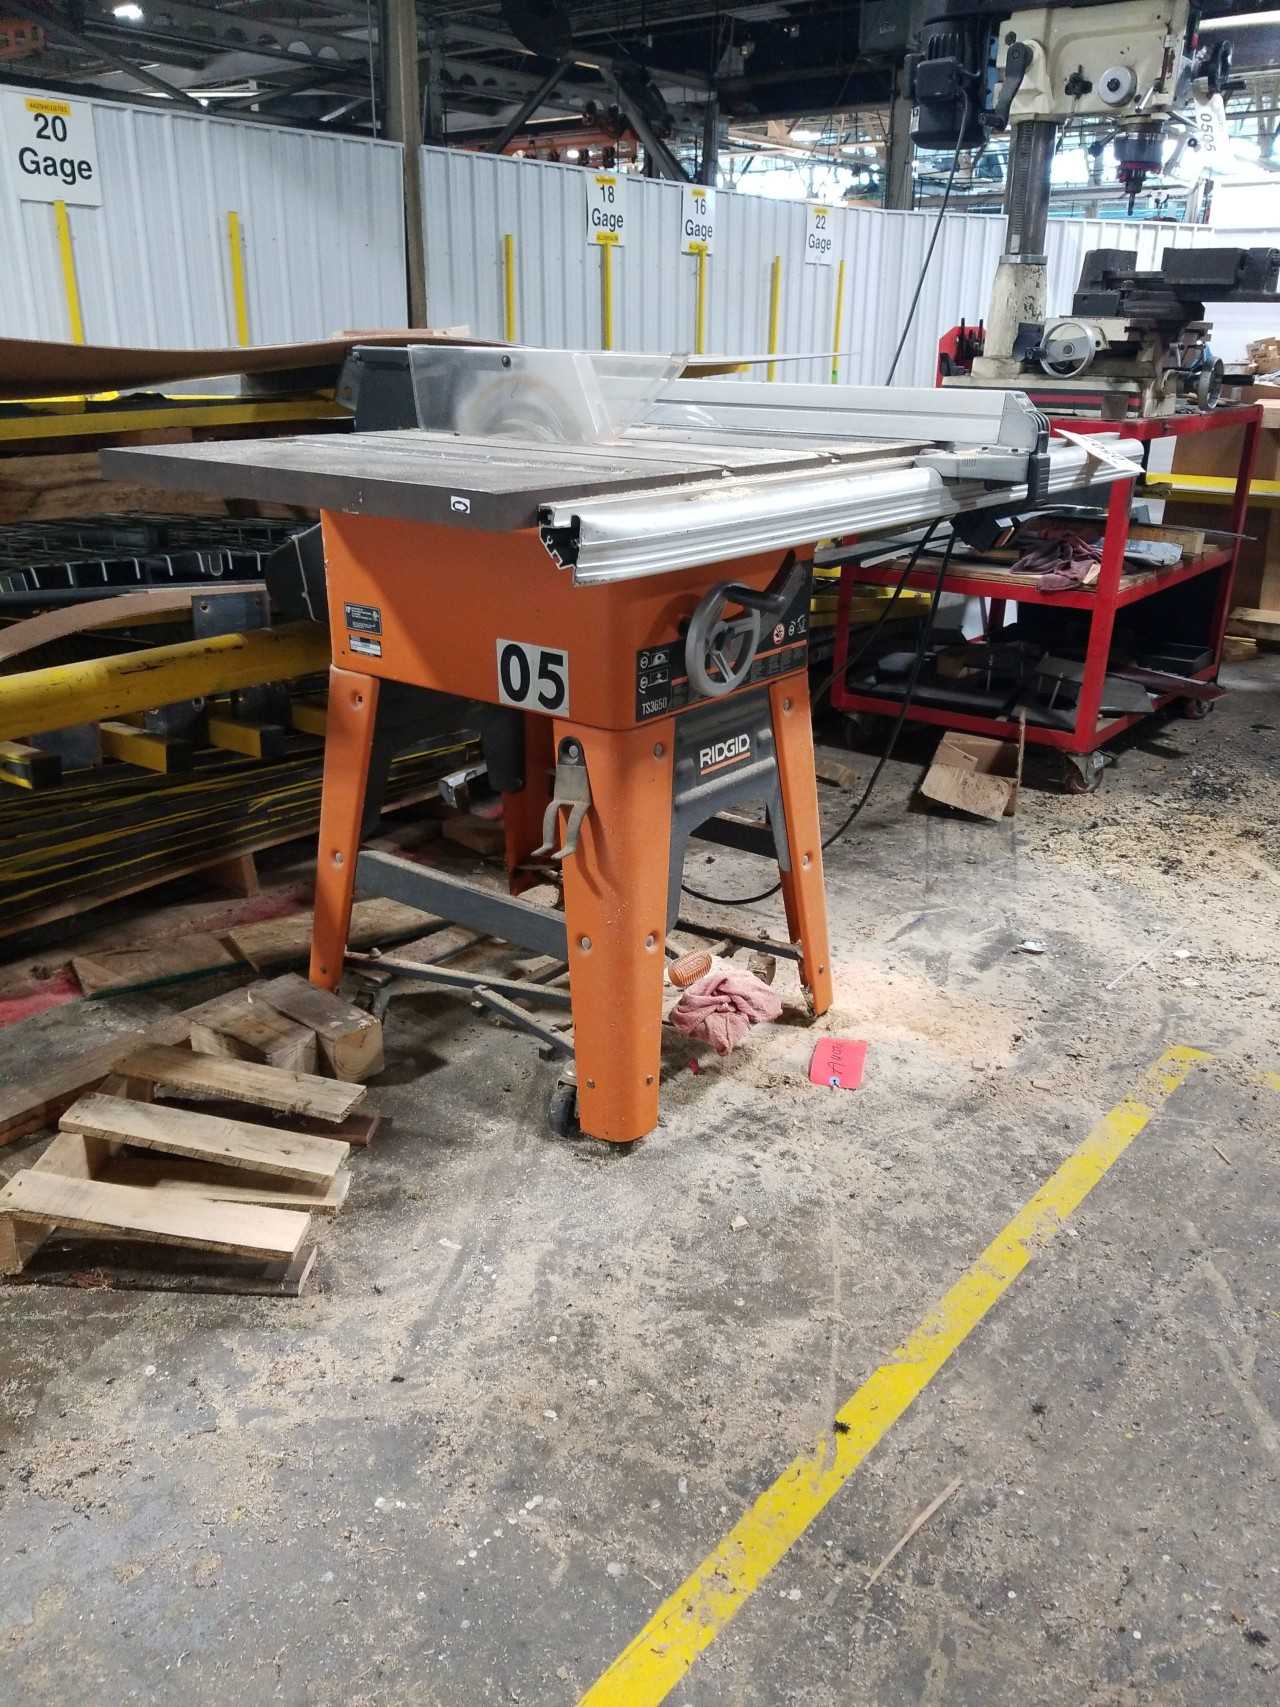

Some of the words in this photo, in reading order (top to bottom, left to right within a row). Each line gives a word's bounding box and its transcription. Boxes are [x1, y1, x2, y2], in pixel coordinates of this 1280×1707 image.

[34, 113, 67, 142] 20
[18, 147, 93, 185] Gage
[600, 184, 615, 203] 18
[695, 197, 707, 215] 16
[592, 208, 624, 232] Gage
[685, 219, 713, 242] Gage
[815, 214, 826, 230] 22
[808, 233, 832, 254] Gage
[500, 643, 566, 710] 05
[641, 697, 668, 716] TS3650
[699, 733, 751, 769] RIDGID
